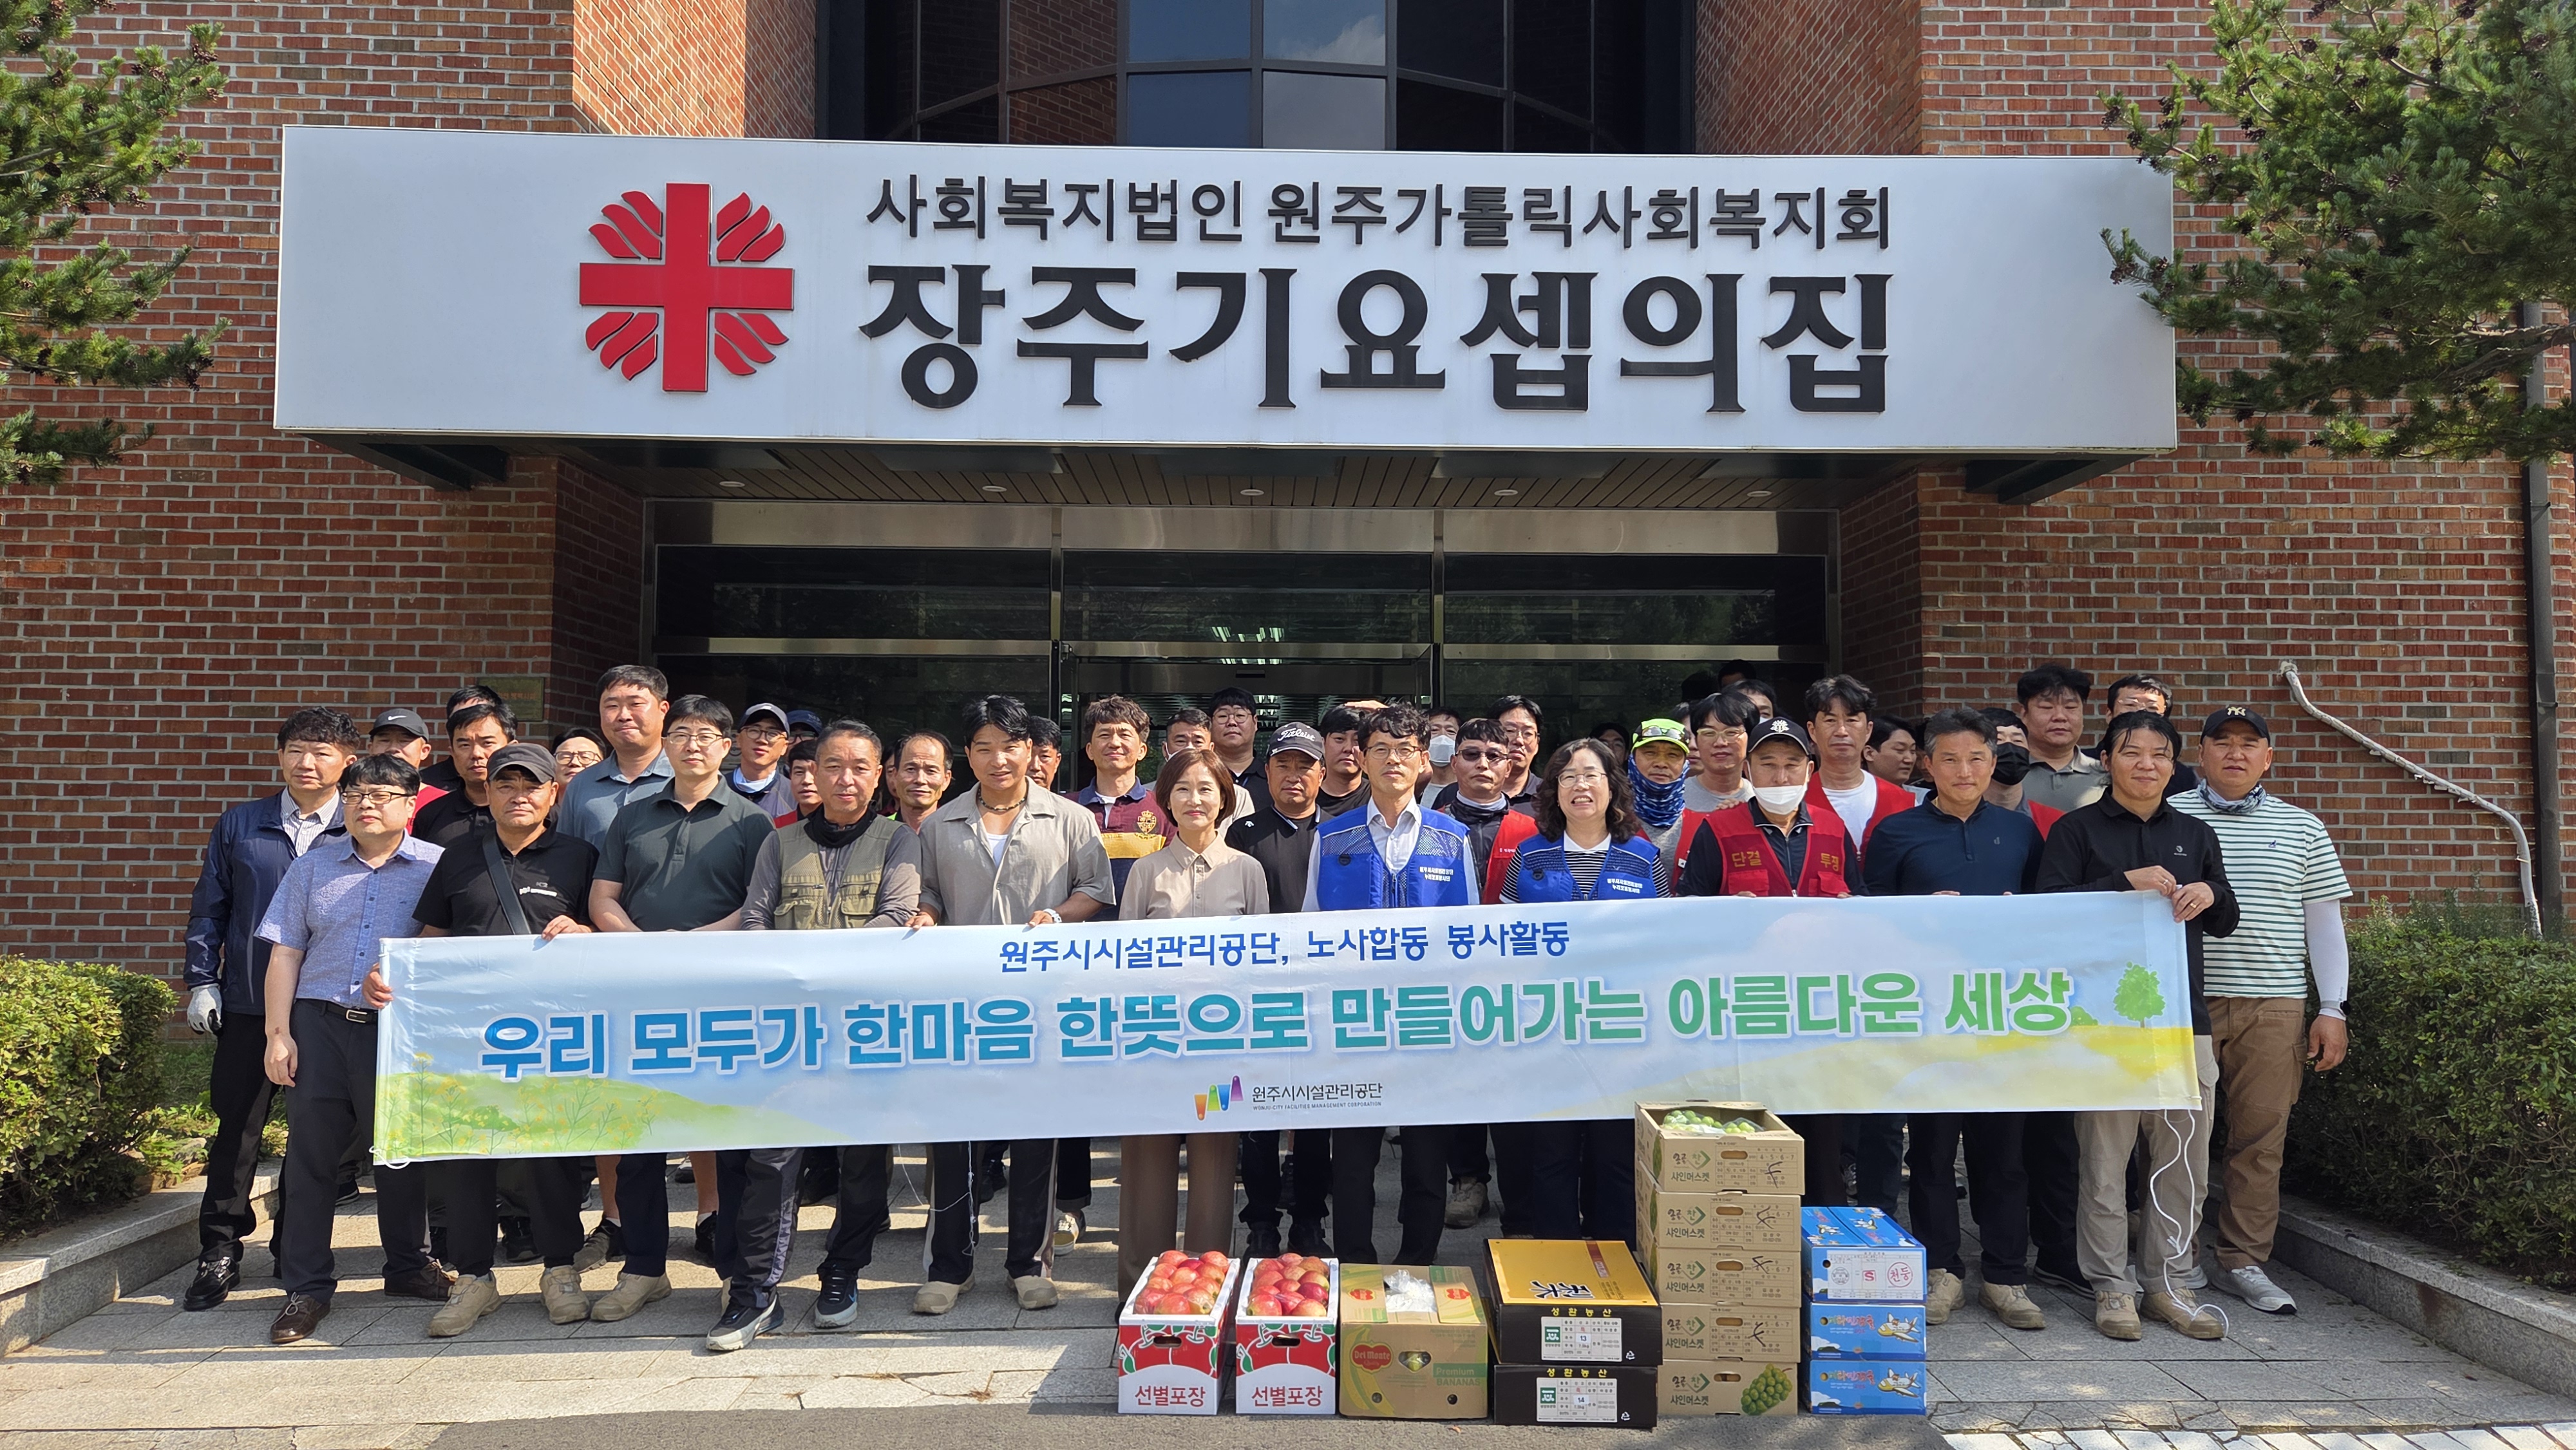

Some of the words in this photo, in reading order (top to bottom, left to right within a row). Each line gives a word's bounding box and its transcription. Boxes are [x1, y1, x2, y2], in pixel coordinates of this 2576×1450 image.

[866, 174, 1243, 242] 사회복지법인
[1267, 181, 1890, 250] 원주가톨릭사회복지회
[858, 263, 1895, 414] 장주기요셉의집
[2227, 706, 2246, 716] NY
[1277, 727, 1316, 742] Titleist
[1731, 850, 1762, 868] 단결
[1820, 852, 1840, 872] 투쟁
[1000, 932, 1289, 973] 원주시시설관리공단,
[1307, 926, 1429, 961] 노사합동
[1447, 921, 1569, 959] 봉사활동
[481, 1013, 607, 1078] 우리
[631, 1004, 824, 1071] 모두가
[845, 999, 1033, 1066] 한마음
[1057, 992, 1307, 1057] 한뜻으로
[1331, 979, 1645, 1048] 만들어가는
[1669, 972, 1921, 1035] 아름다운
[1945, 970, 2070, 1032] 세상
[1252, 1082, 1383, 1102] 원주시시설관리공단
[1671, 1172, 1709, 1182] 샤인머스켓
[1666, 1227, 1705, 1238] 샤인머스켓
[1864, 1271, 1875, 1281] S
[1665, 1281, 1704, 1293] 샤인머스켓
[1665, 1338, 1703, 1349] 샤인머스켓
[1354, 1350, 1366, 1359] Del
[1367, 1351, 1390, 1361] Monte
[1436, 1367, 1475, 1375] Premium
[1437, 1378, 1481, 1386] BANANAS
[1135, 1386, 1206, 1408] 선별포장
[1251, 1386, 1323, 1408] 선별포장
[1671, 1395, 1709, 1406] 샤인머스켓
